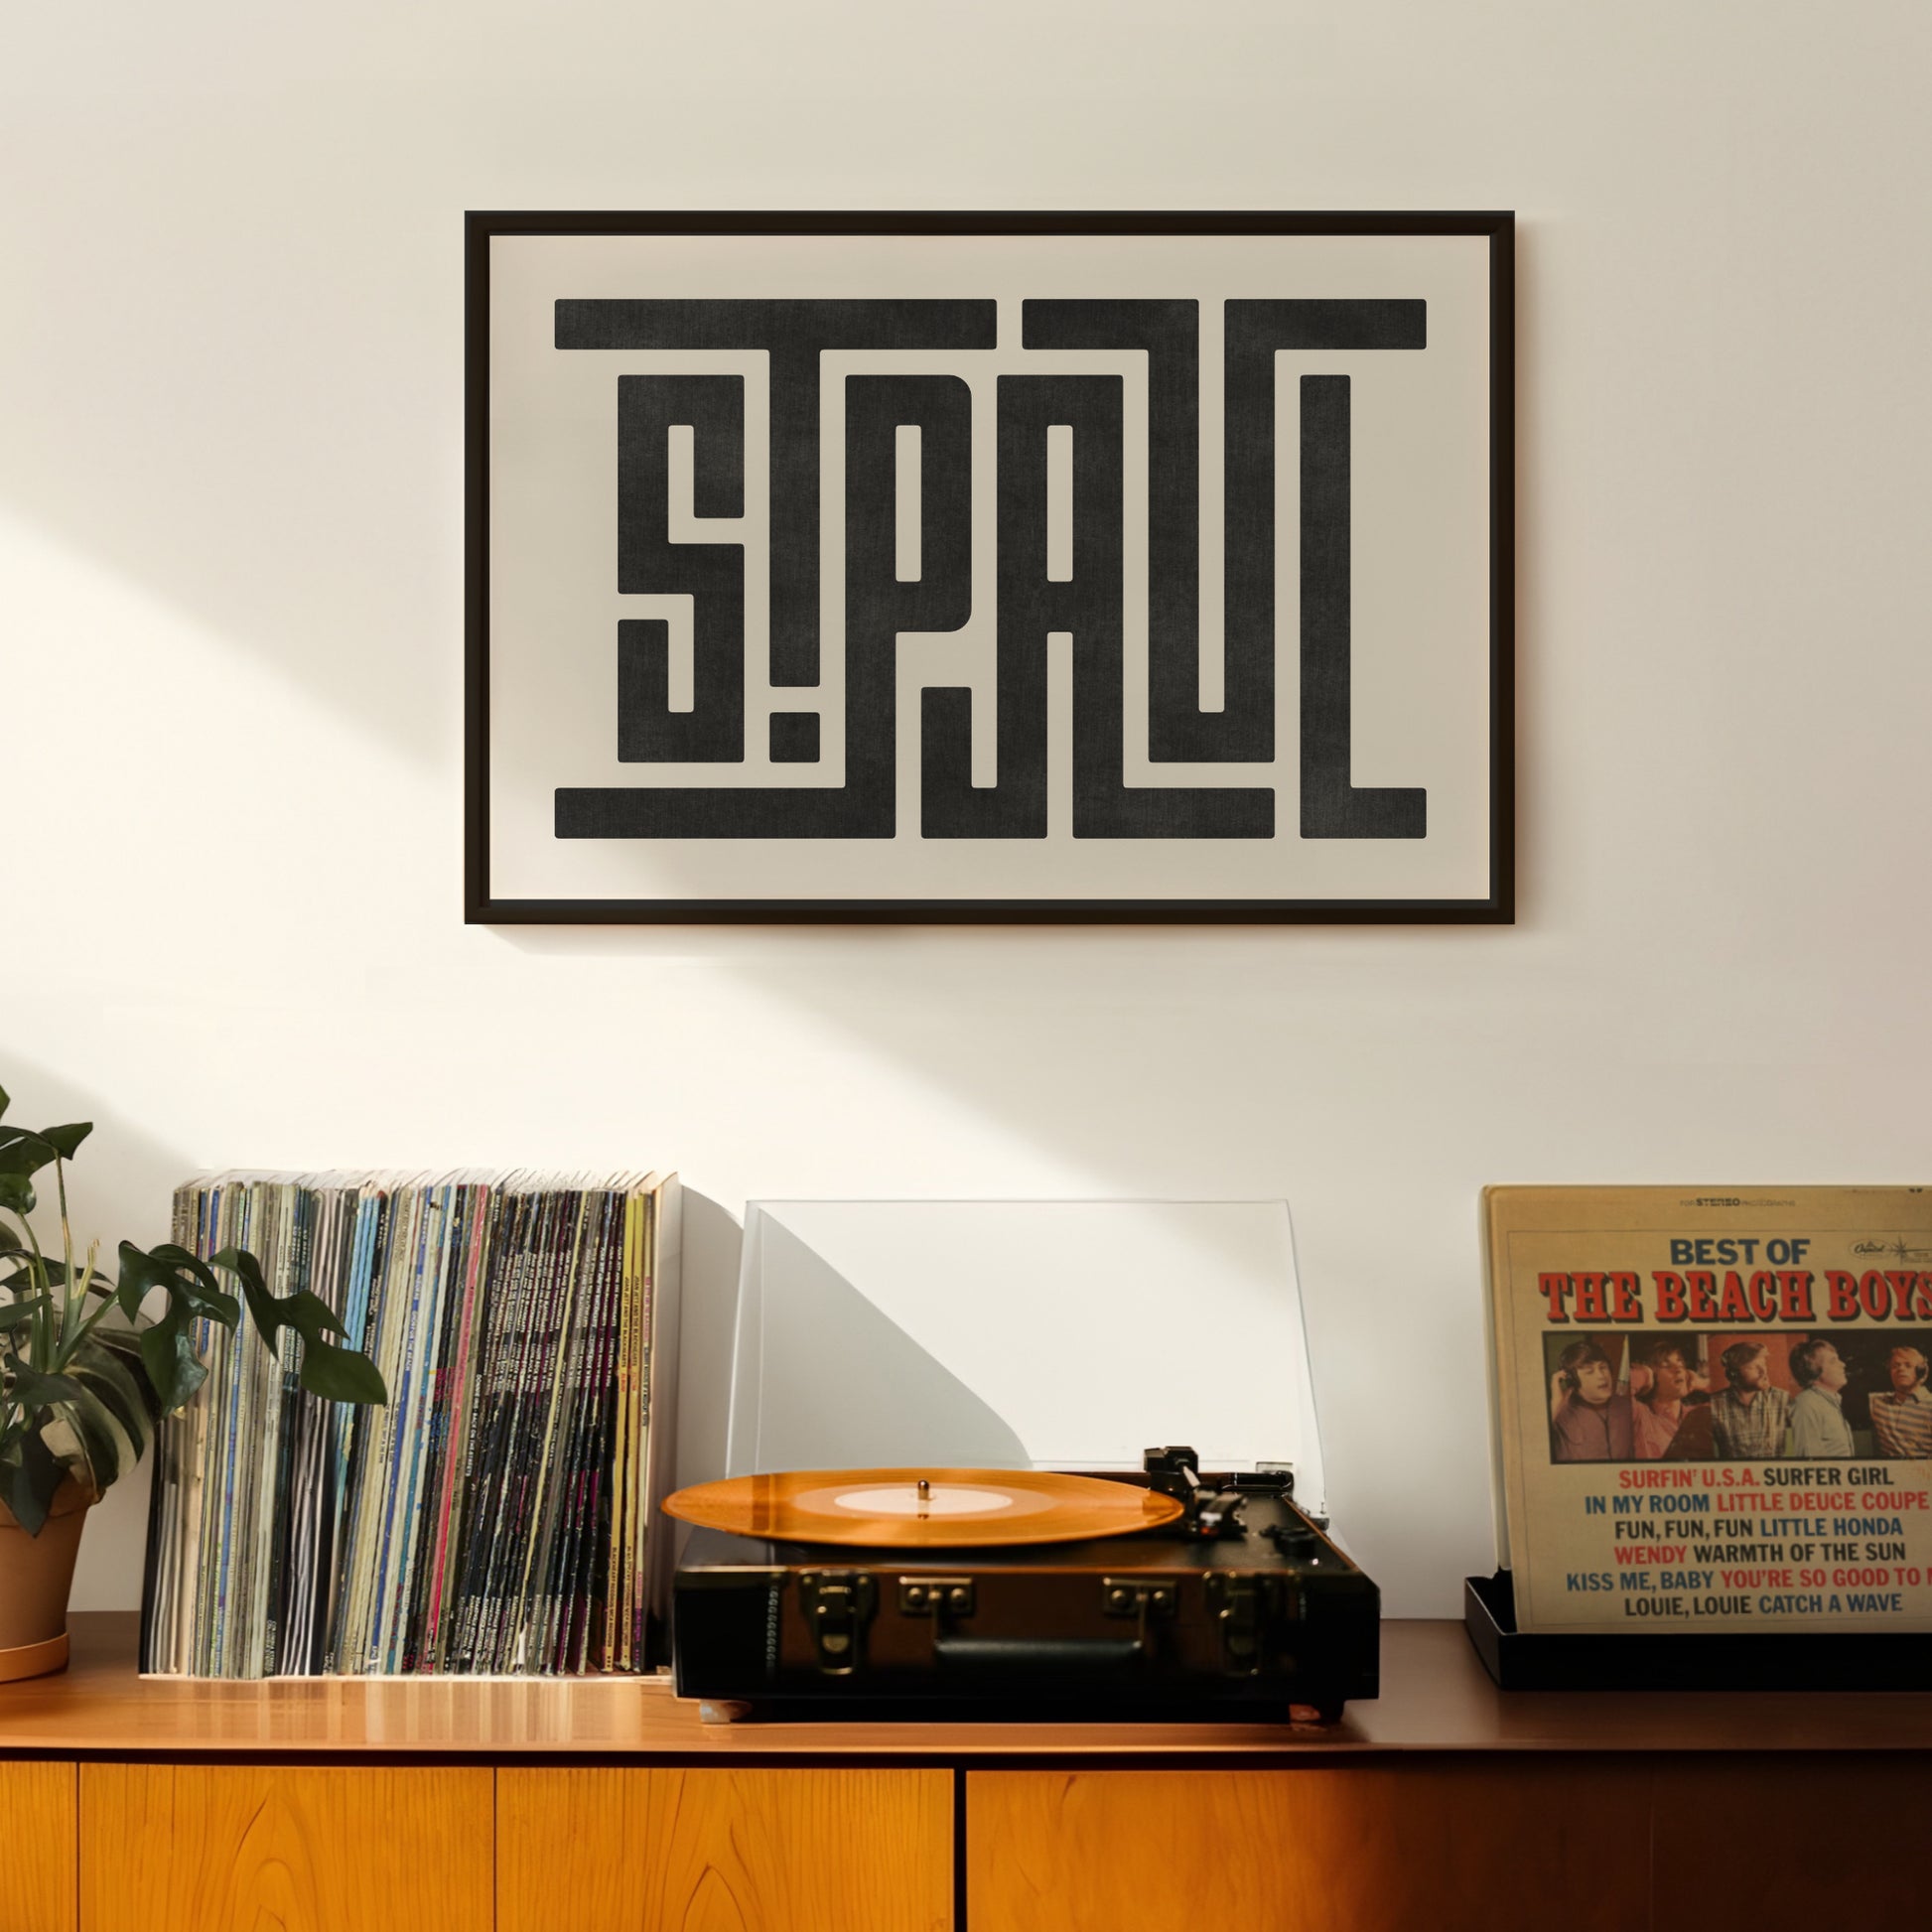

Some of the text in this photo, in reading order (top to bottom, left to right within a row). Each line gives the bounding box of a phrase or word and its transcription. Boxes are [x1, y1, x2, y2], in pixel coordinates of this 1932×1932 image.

[1670, 1238, 1811, 1266] BEST OF
[1538, 1269, 1932, 1323] THE BEACH BOYS
[1619, 1467, 1894, 1489] SURFIN' U.S.A. SURFER GIRL
[1586, 1491, 1930, 1514] IN MY ROOM LITTLE DEUCE COUPE
[1615, 1517, 1903, 1542] FUN, FUN, FUN LITTLE HONDA
[1614, 1542, 1906, 1565] WENDY WARMTH OF THE SUN
[1567, 1573, 1614, 1592] KISS
[1620, 1572, 1657, 1593] ME,
[1660, 1571, 1715, 1589] BABY
[1720, 1569, 1794, 1588] YOU'RE
[1800, 1569, 1827, 1587] SO
[1833, 1568, 1889, 1587] GOOD
[1893, 1568, 1921, 1587] TO
[1625, 1593, 1903, 1619] LOUIE, LOUIE CATCH A WAVE
